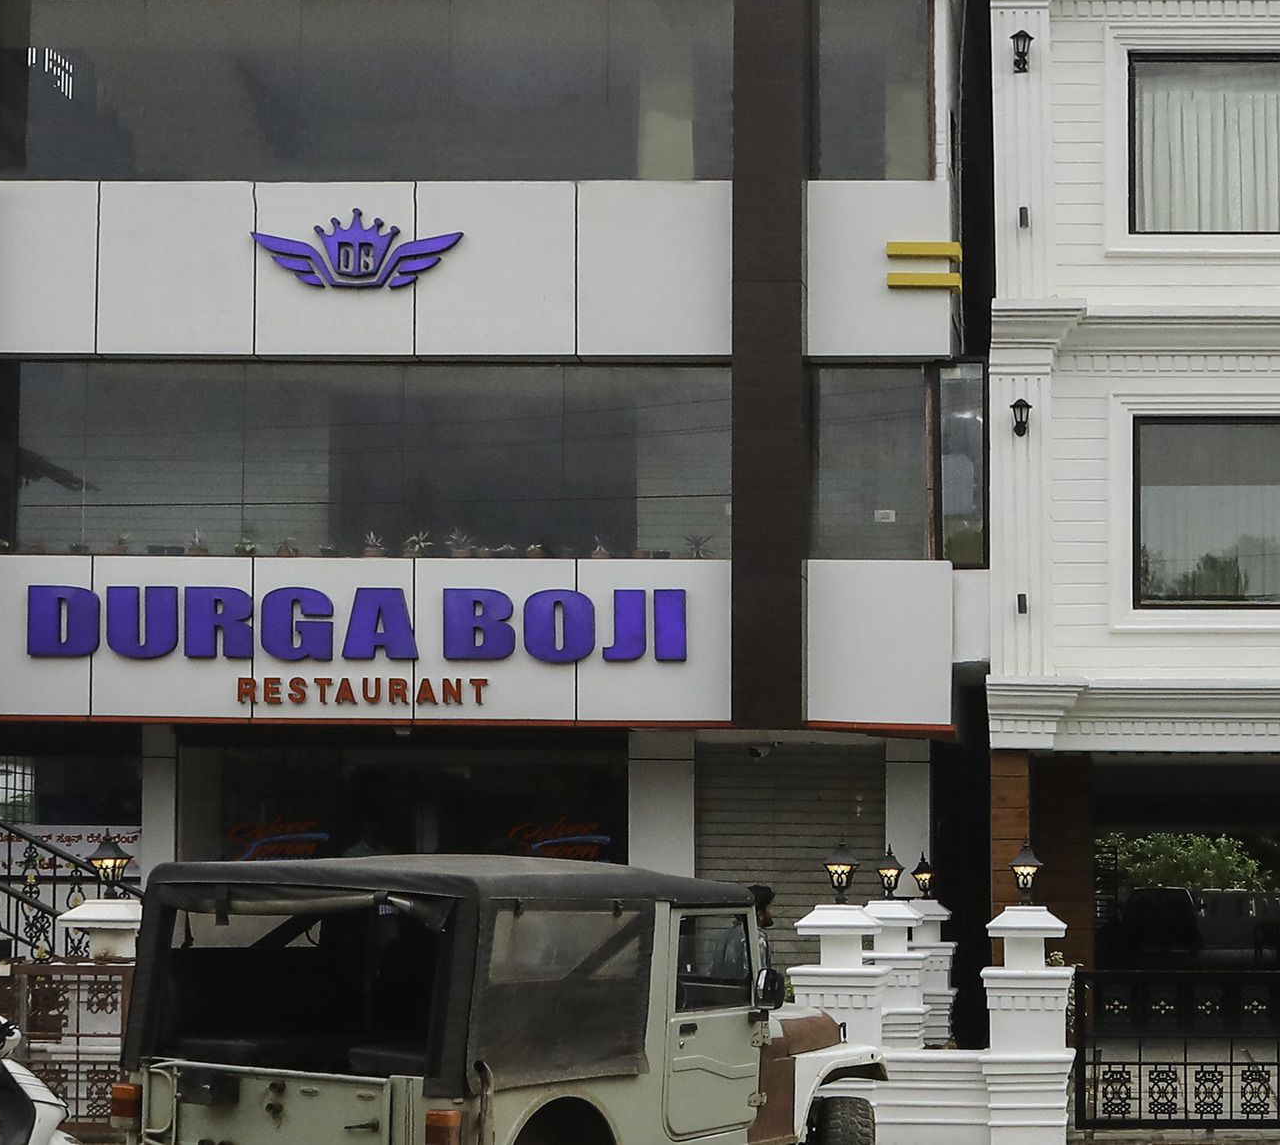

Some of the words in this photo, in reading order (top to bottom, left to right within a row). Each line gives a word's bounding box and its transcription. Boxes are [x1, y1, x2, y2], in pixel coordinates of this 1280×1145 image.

[27, 585, 419, 660] DURGA
[442, 587, 688, 663] BOJI
[236, 677, 489, 705] RESTAURANT
